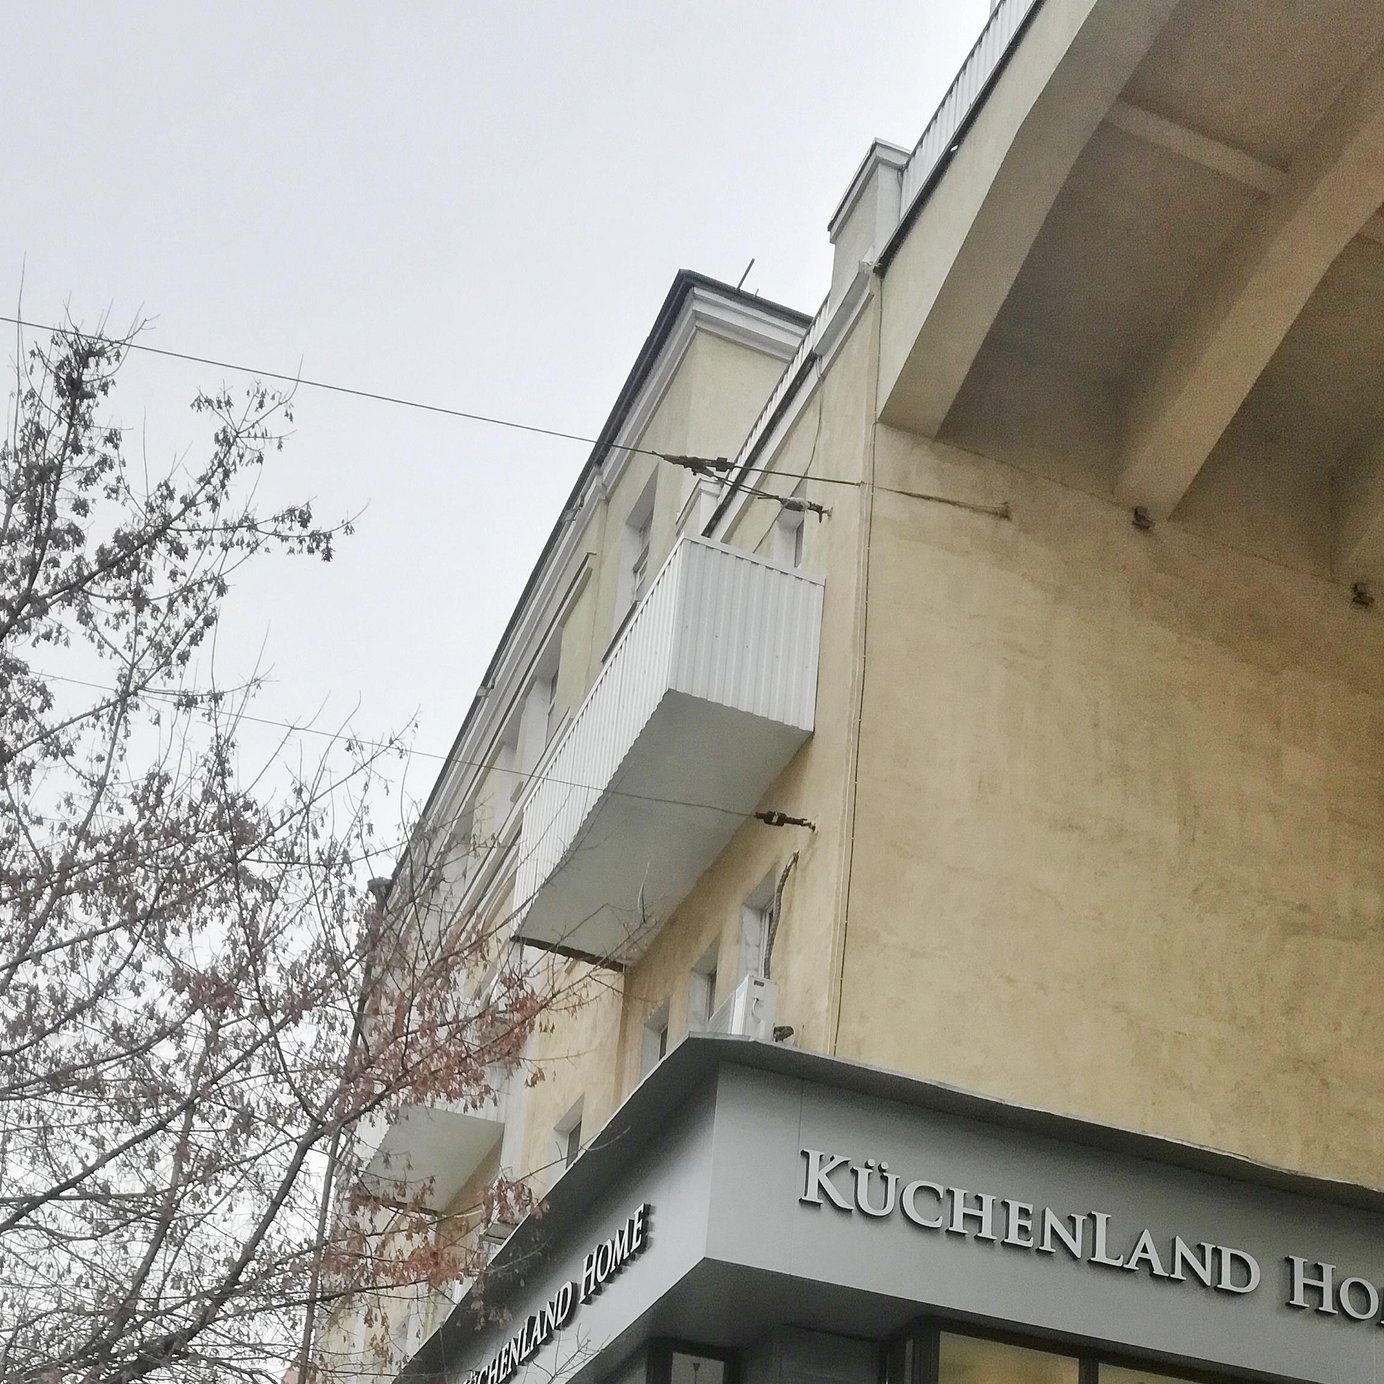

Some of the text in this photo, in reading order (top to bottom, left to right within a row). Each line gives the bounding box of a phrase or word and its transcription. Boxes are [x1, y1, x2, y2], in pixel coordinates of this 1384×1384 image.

[579, 1202, 650, 1304] HOME
[799, 1148, 1384, 1325] KÜCHENLAND HO
